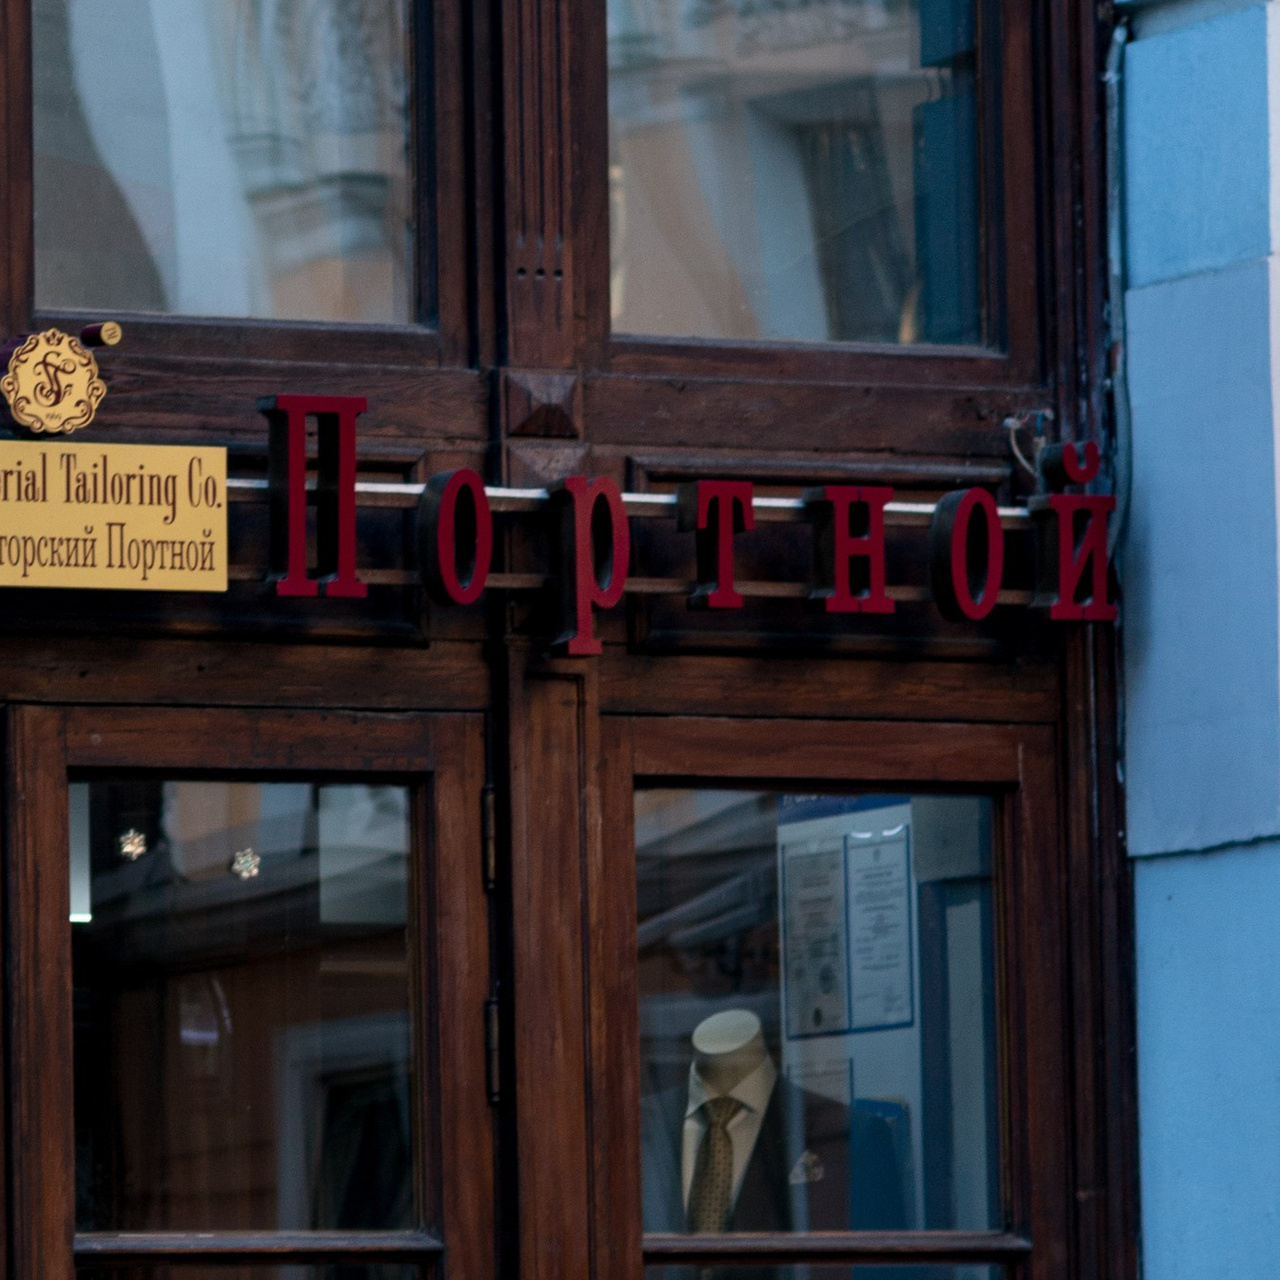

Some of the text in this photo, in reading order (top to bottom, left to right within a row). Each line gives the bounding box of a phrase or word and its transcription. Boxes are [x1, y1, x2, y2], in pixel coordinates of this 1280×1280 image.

[59, 452, 178, 525] Tailoring
[187, 456, 223, 509] Co.
[274, 394, 1118, 655] Портной
[105, 522, 216, 581] Портной
